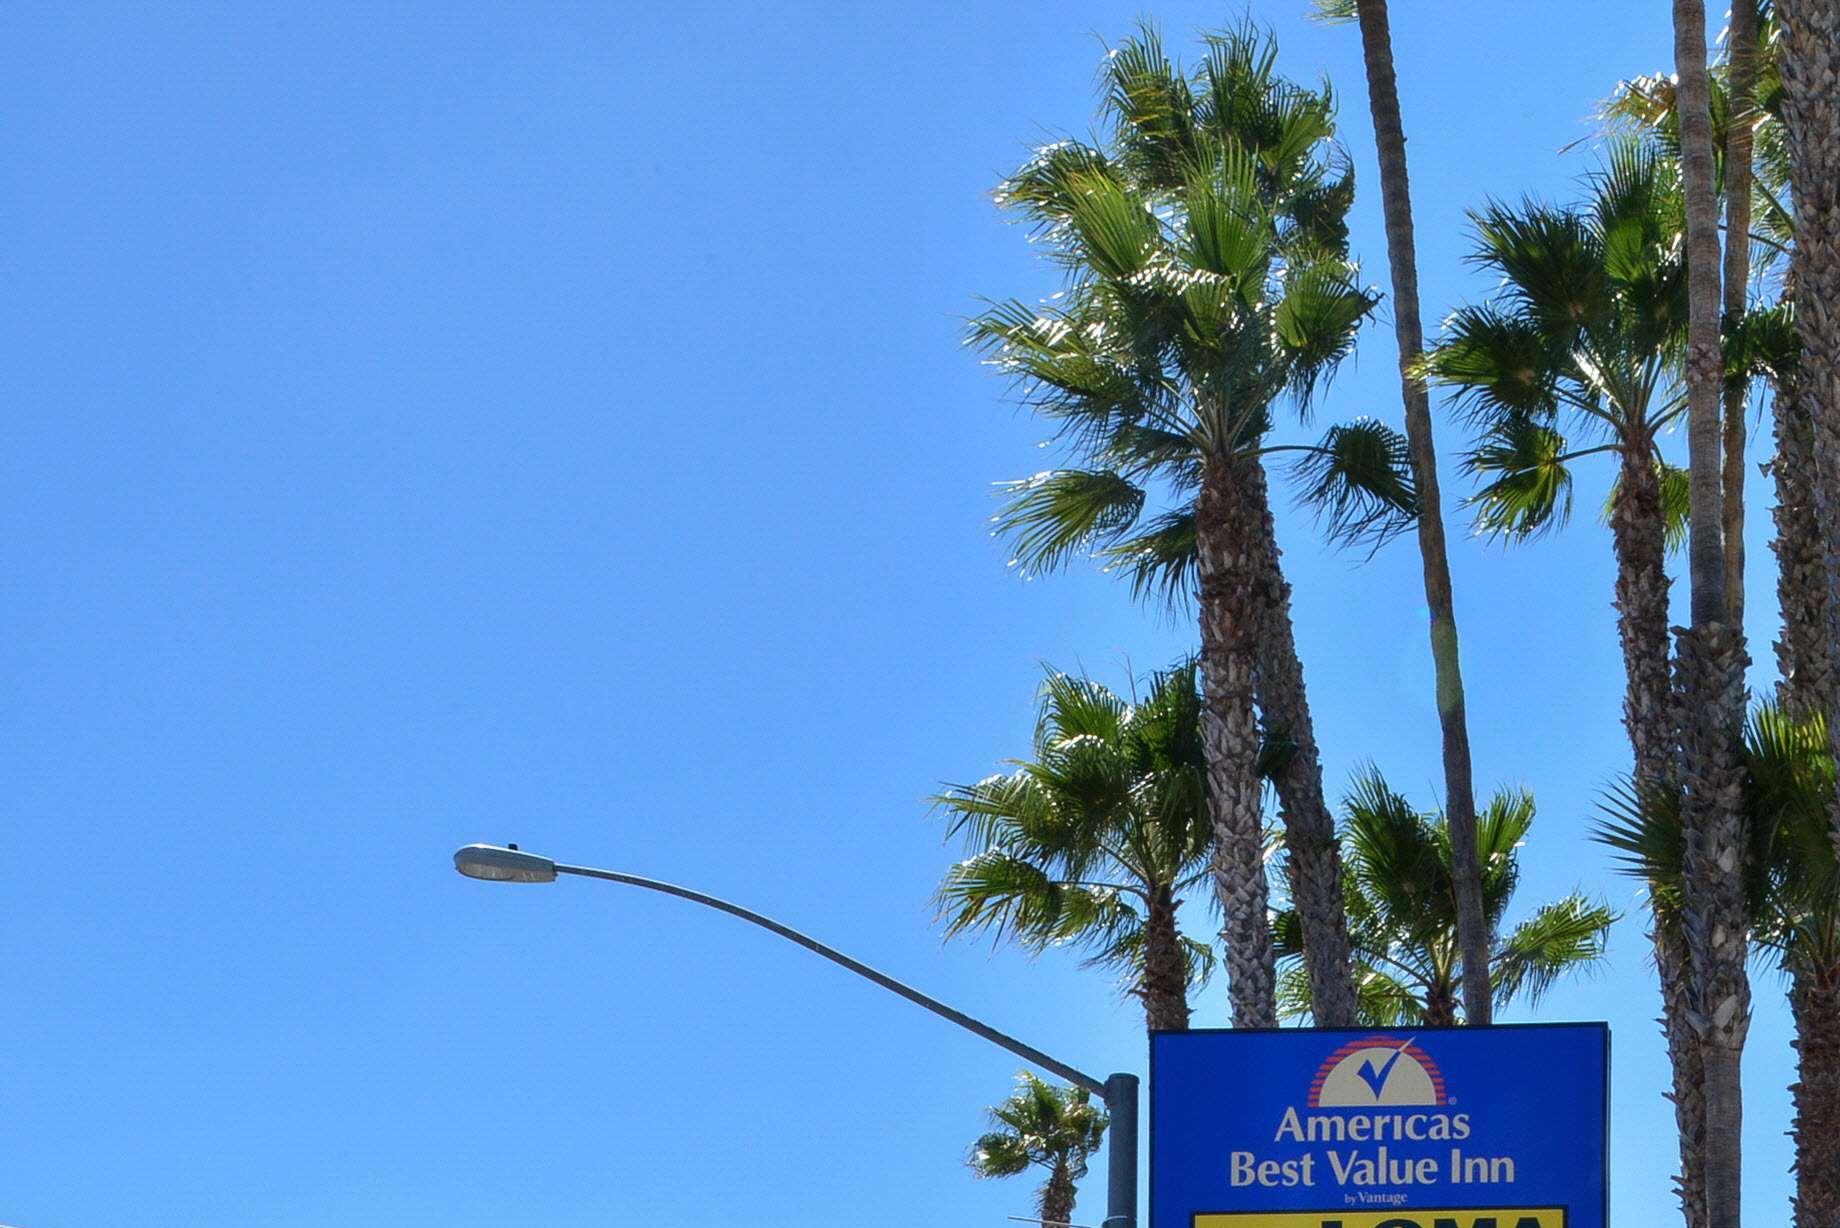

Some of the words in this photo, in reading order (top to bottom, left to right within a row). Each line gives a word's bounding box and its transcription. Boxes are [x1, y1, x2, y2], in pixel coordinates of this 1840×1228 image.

[1274, 1106, 1471, 1142] Americas
[1229, 1151, 1315, 1187] Best
[1327, 1146, 1438, 1186] Value
[1451, 1148, 1515, 1184] Inn
[1344, 1193, 1357, 1206] by
[1357, 1192, 1408, 1206] Vantage
